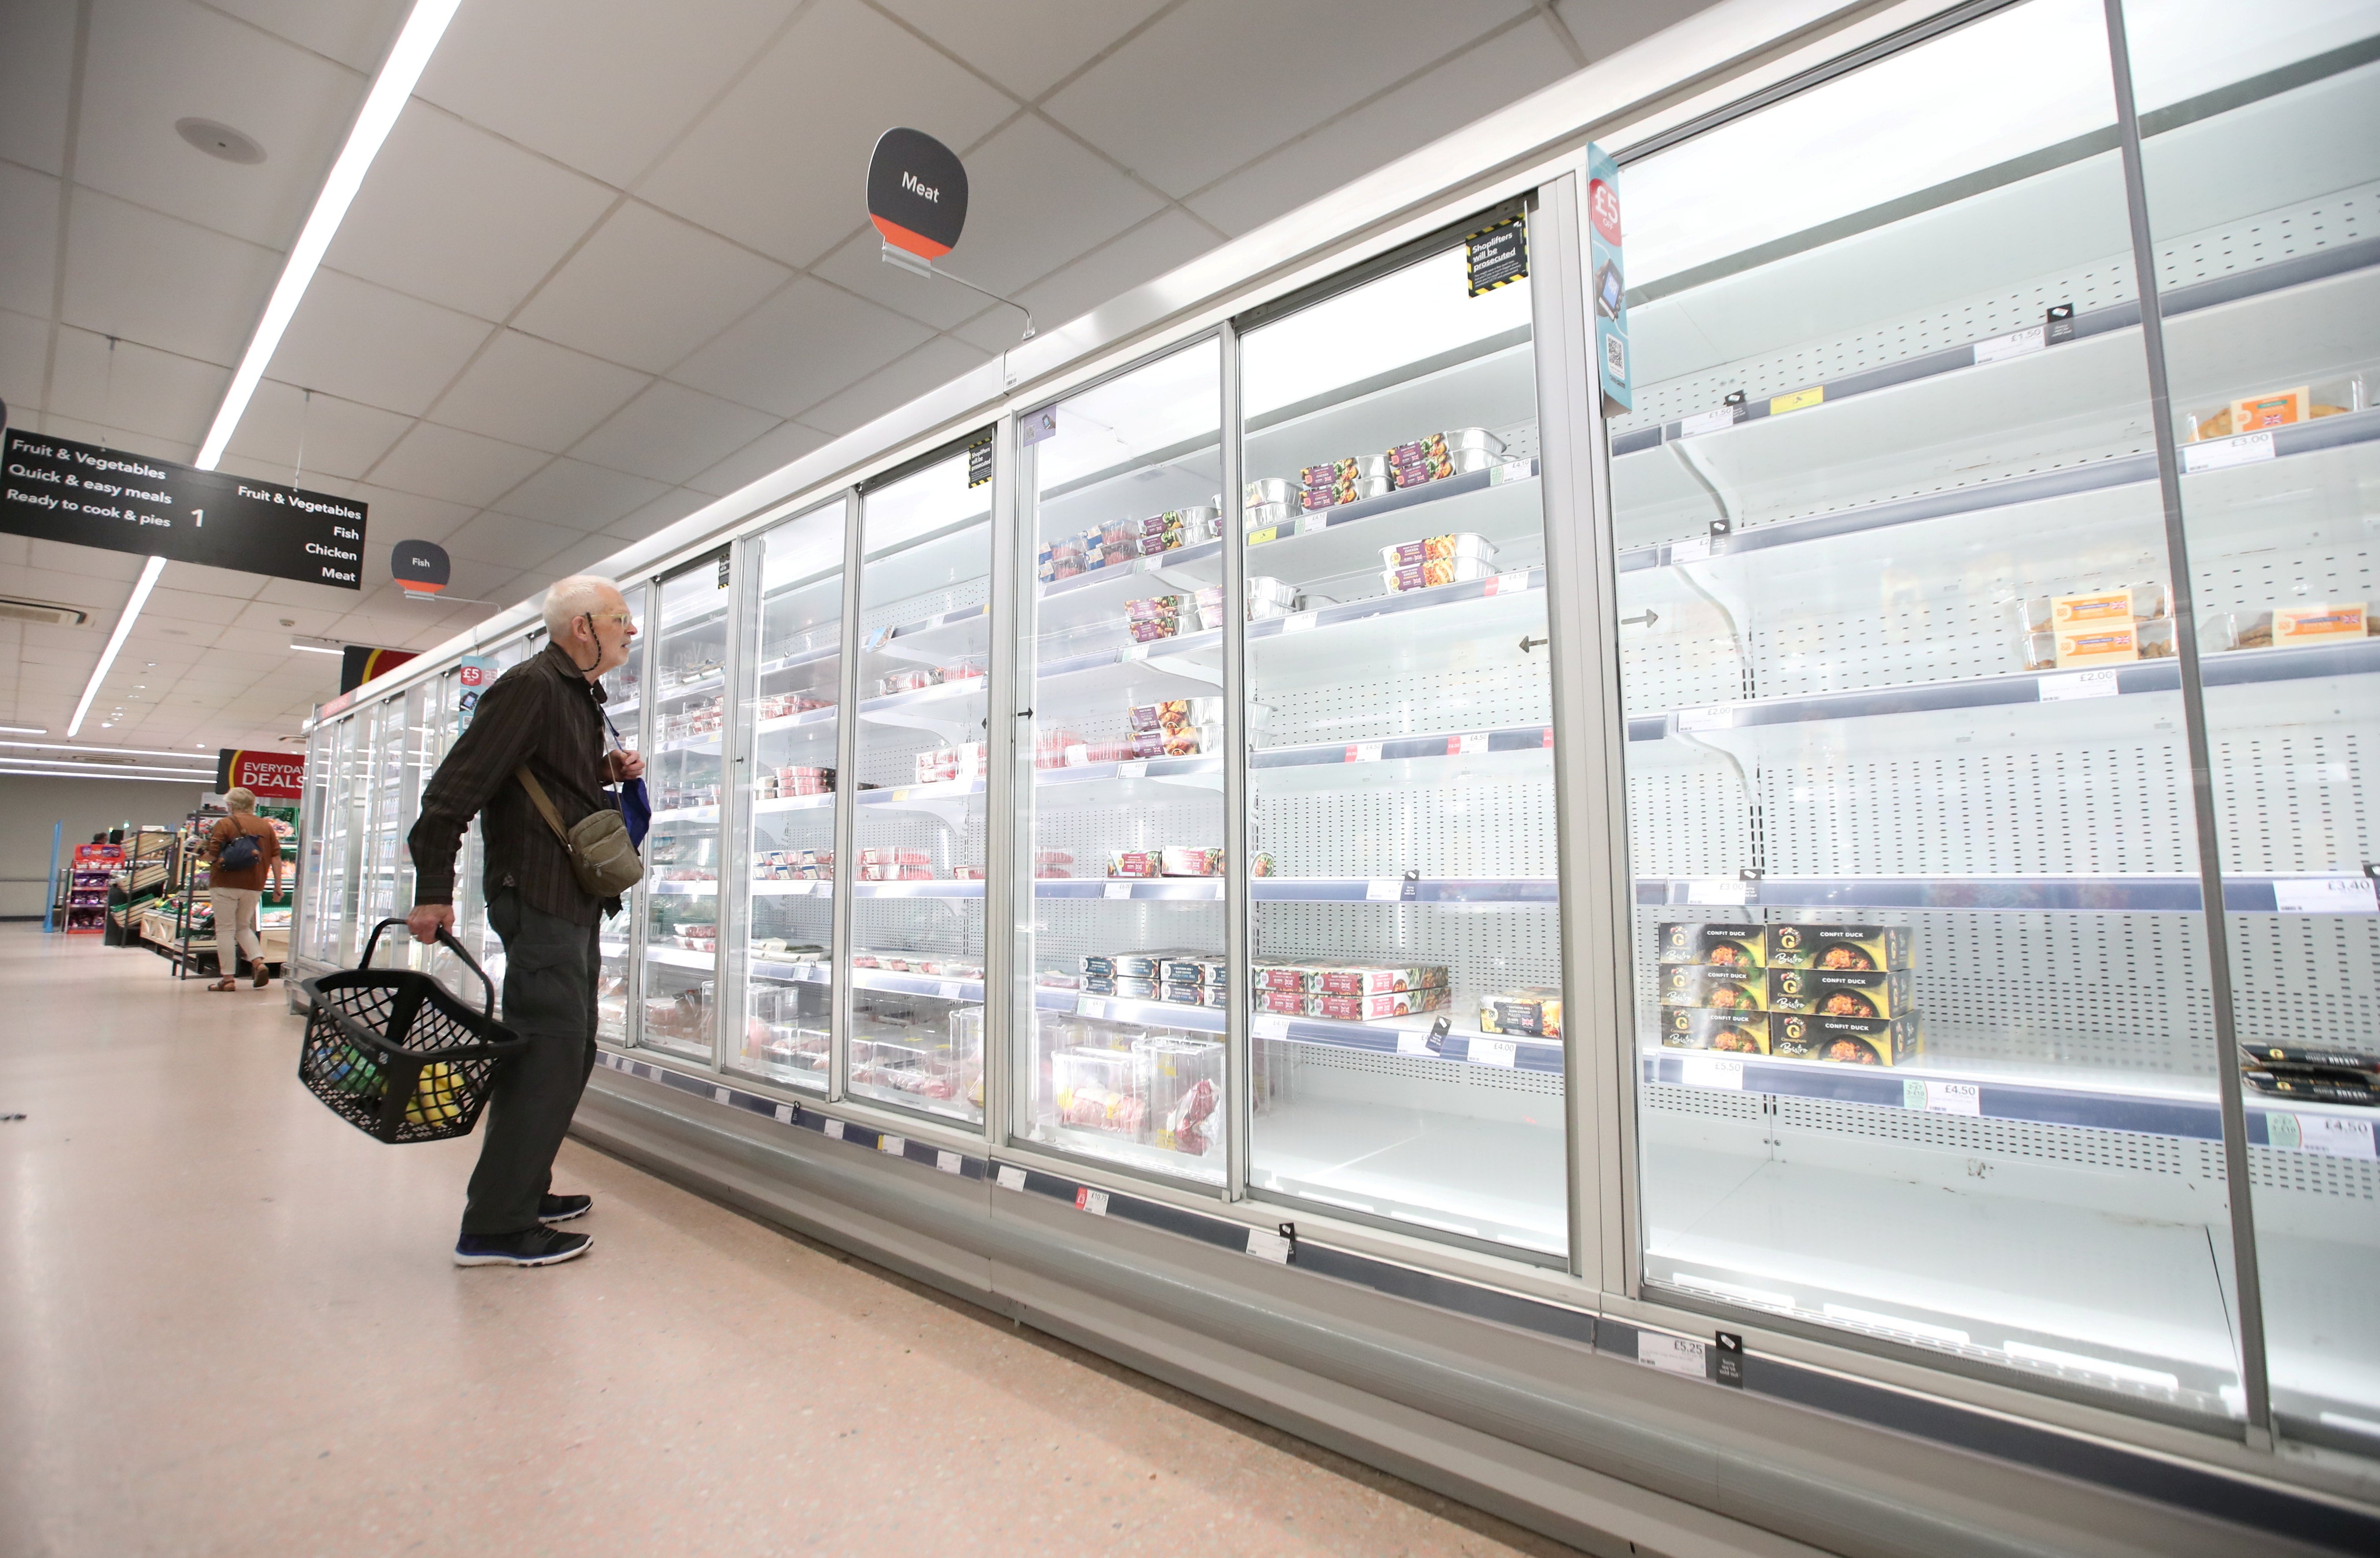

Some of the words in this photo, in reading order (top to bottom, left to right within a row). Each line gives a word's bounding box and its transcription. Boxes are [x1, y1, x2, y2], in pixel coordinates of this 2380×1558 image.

[902, 171, 940, 203] Meat
[1595, 185, 1618, 223] £5
[1603, 218, 1613, 229] OFF
[1472, 233, 1513, 254] Shoplifters
[1473, 250, 1486, 262] will
[1487, 248, 1498, 256] be
[1473, 247, 1516, 273] prosecuted
[2011, 329, 2041, 342] £1.50
[1709, 407, 1731, 418] £1.50
[2231, 433, 2269, 447] £3.00
[12, 439, 52, 456] Fruit
[56, 448, 70, 460] &
[75, 451, 166, 480] Vegetables
[1512, 459, 1529, 468] £4.10
[8, 464, 61, 483] Quick
[65, 474, 79, 486] &
[84, 479, 121, 496] easy
[125, 487, 173, 504] meals
[7, 488, 59, 509] Ready
[61, 500, 79, 511] to
[82, 504, 121, 518] cook
[124, 510, 137, 521] &
[139, 514, 171, 528] pies
[238, 485, 270, 502] Fruit
[273, 493, 285, 505] &
[289, 495, 362, 520] Vegetables
[191, 508, 204, 527] 1
[333, 526, 359, 540] Fish
[305, 543, 357, 561] Chicken
[412, 557, 430, 568] Fish
[322, 566, 356, 582] Meat
[463, 668, 479, 679] £5
[2080, 671, 2113, 682] £2.00
[242, 772, 304, 789] DEALS
[2328, 881, 2370, 891] £3.40
[1666, 950, 1691, 960] Bistro
[1775, 953, 1803, 965] Bistro
[1667, 992, 1692, 1002] Bistro
[1777, 998, 1805, 1010] Bistro
[1670, 1033, 1695, 1044] Bistro
[1493, 1043, 1514, 1052] £4.00
[1780, 1042, 1808, 1055] Bistro
[1715, 1062, 1740, 1071] £5.50
[1945, 1085, 1975, 1095] £4.50
[1077, 1195, 1085, 1204] £3
[1091, 1192, 1107, 1202] £10.75
[1674, 1340, 1703, 1354] £5.25
